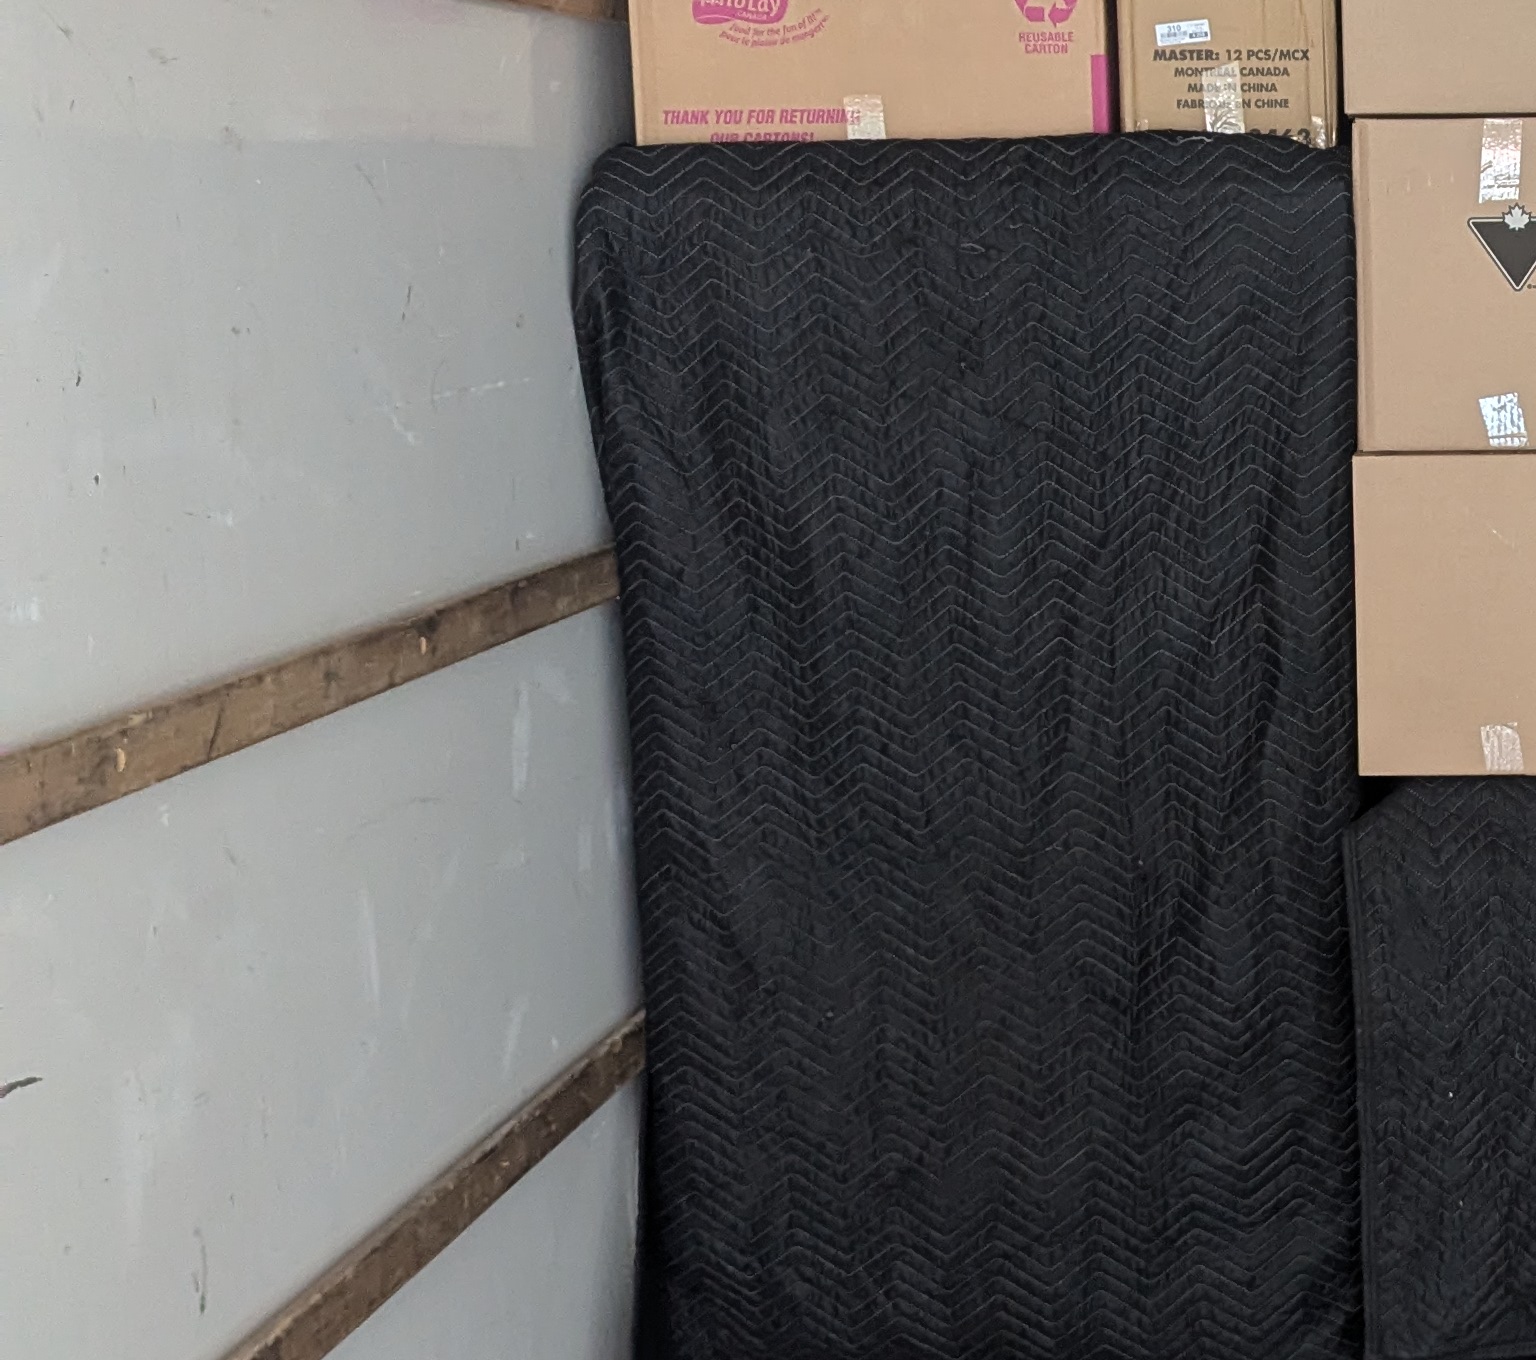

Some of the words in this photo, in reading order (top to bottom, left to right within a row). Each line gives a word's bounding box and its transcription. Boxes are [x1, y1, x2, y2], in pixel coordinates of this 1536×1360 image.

[1018, 31, 1074, 42] REUSABLE
[1024, 43, 1068, 54] CARTON
[1153, 49, 1219, 61] MASTER:
[1226, 49, 1242, 61] 12
[1247, 49, 1309, 61] PCS/MCX
[1239, 67, 1290, 77] CANADA
[1187, 83, 1220, 93] MADE
[1240, 83, 1278, 93] CHINA
[1254, 99, 1289, 108] CHINE
[662, 109, 710, 125] THANK
[714, 109, 744, 124] YOU
[747, 109, 775, 124] FOR
[710, 132, 739, 143] OUR
[744, 131, 815, 143] CARTONS!
